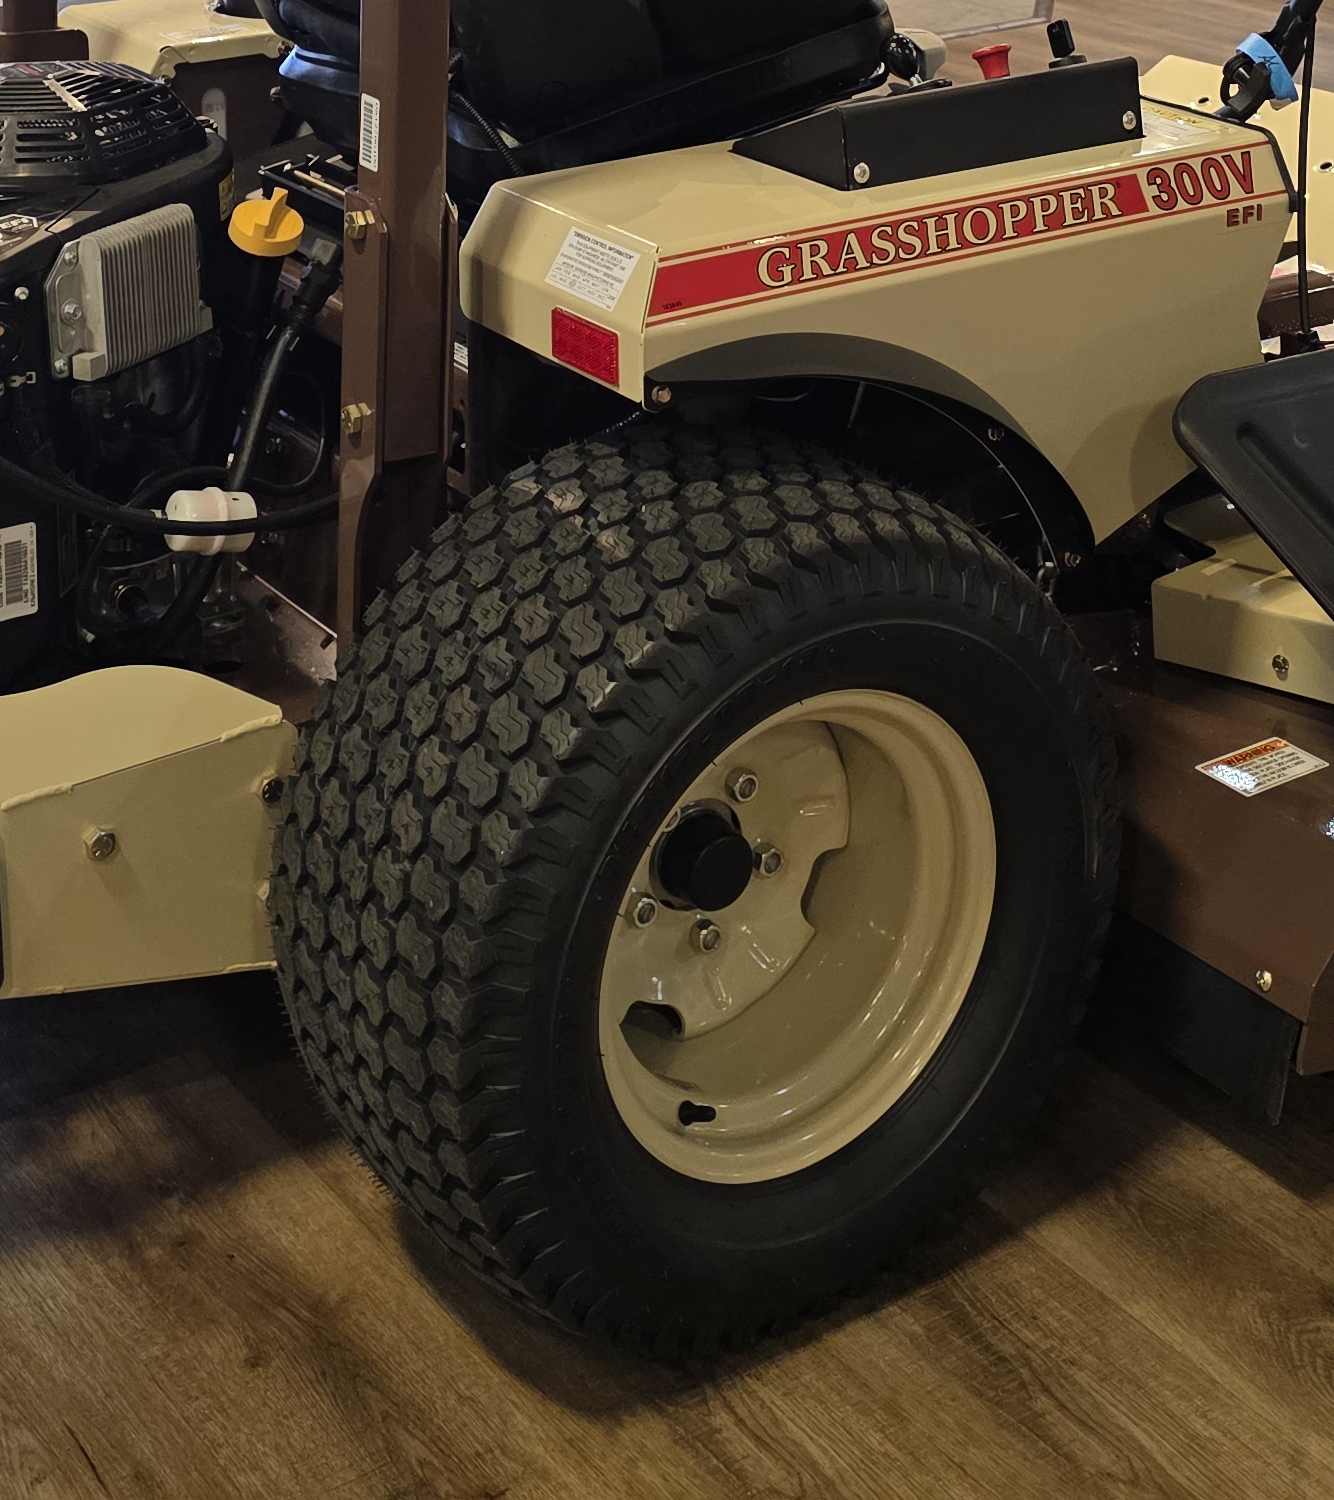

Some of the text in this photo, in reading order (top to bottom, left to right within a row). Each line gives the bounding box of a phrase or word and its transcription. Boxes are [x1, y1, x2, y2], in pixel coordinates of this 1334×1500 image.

[1146, 151, 1255, 211] 300V
[757, 180, 1123, 288] GRASSHOPPER
[1227, 205, 1263, 228] EFI
